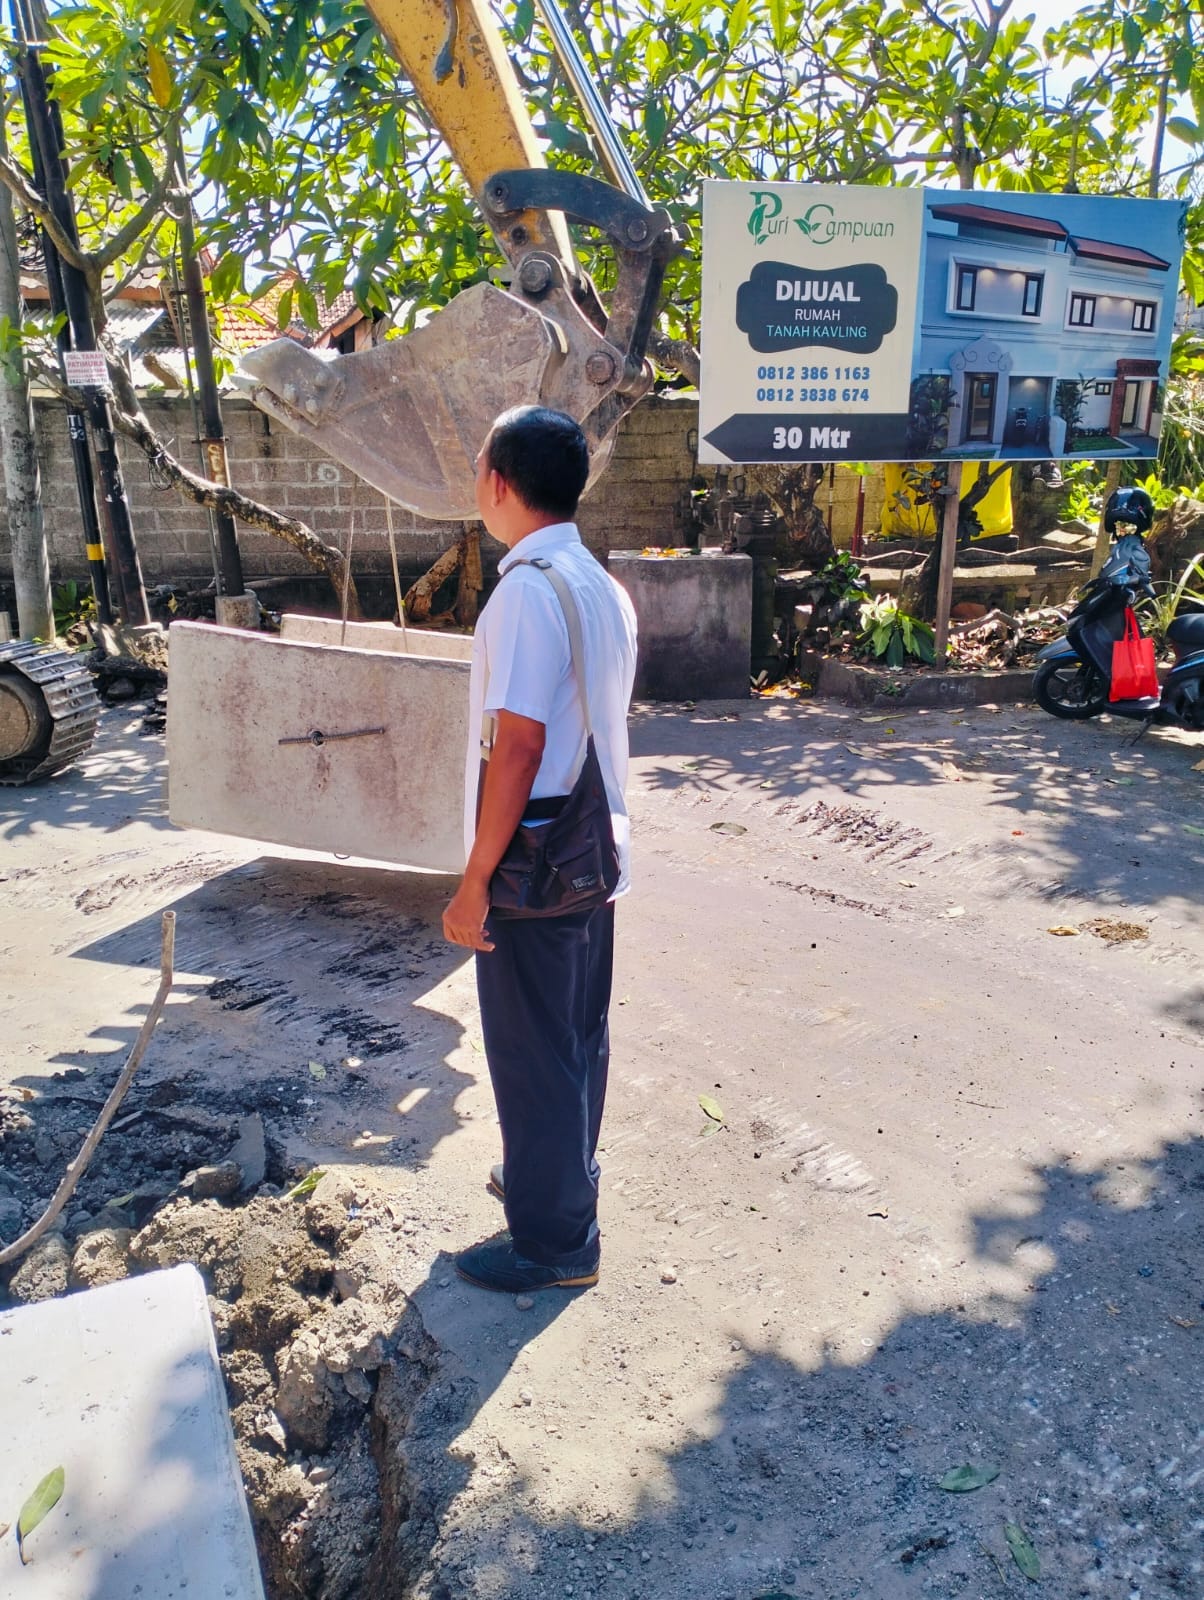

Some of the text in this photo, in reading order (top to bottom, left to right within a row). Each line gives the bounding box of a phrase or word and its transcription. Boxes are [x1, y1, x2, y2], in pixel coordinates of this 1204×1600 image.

[747, 191, 895, 245] Puri Campuan
[775, 279, 861, 302] DIJUAL
[794, 308, 841, 321] RUMAH
[766, 324, 867, 339] TANAH KAVLING
[757, 366, 871, 381] 0812 386 1163
[756, 388, 870, 402] 0812 3838 674
[772, 426, 852, 450] 30 Mtr
